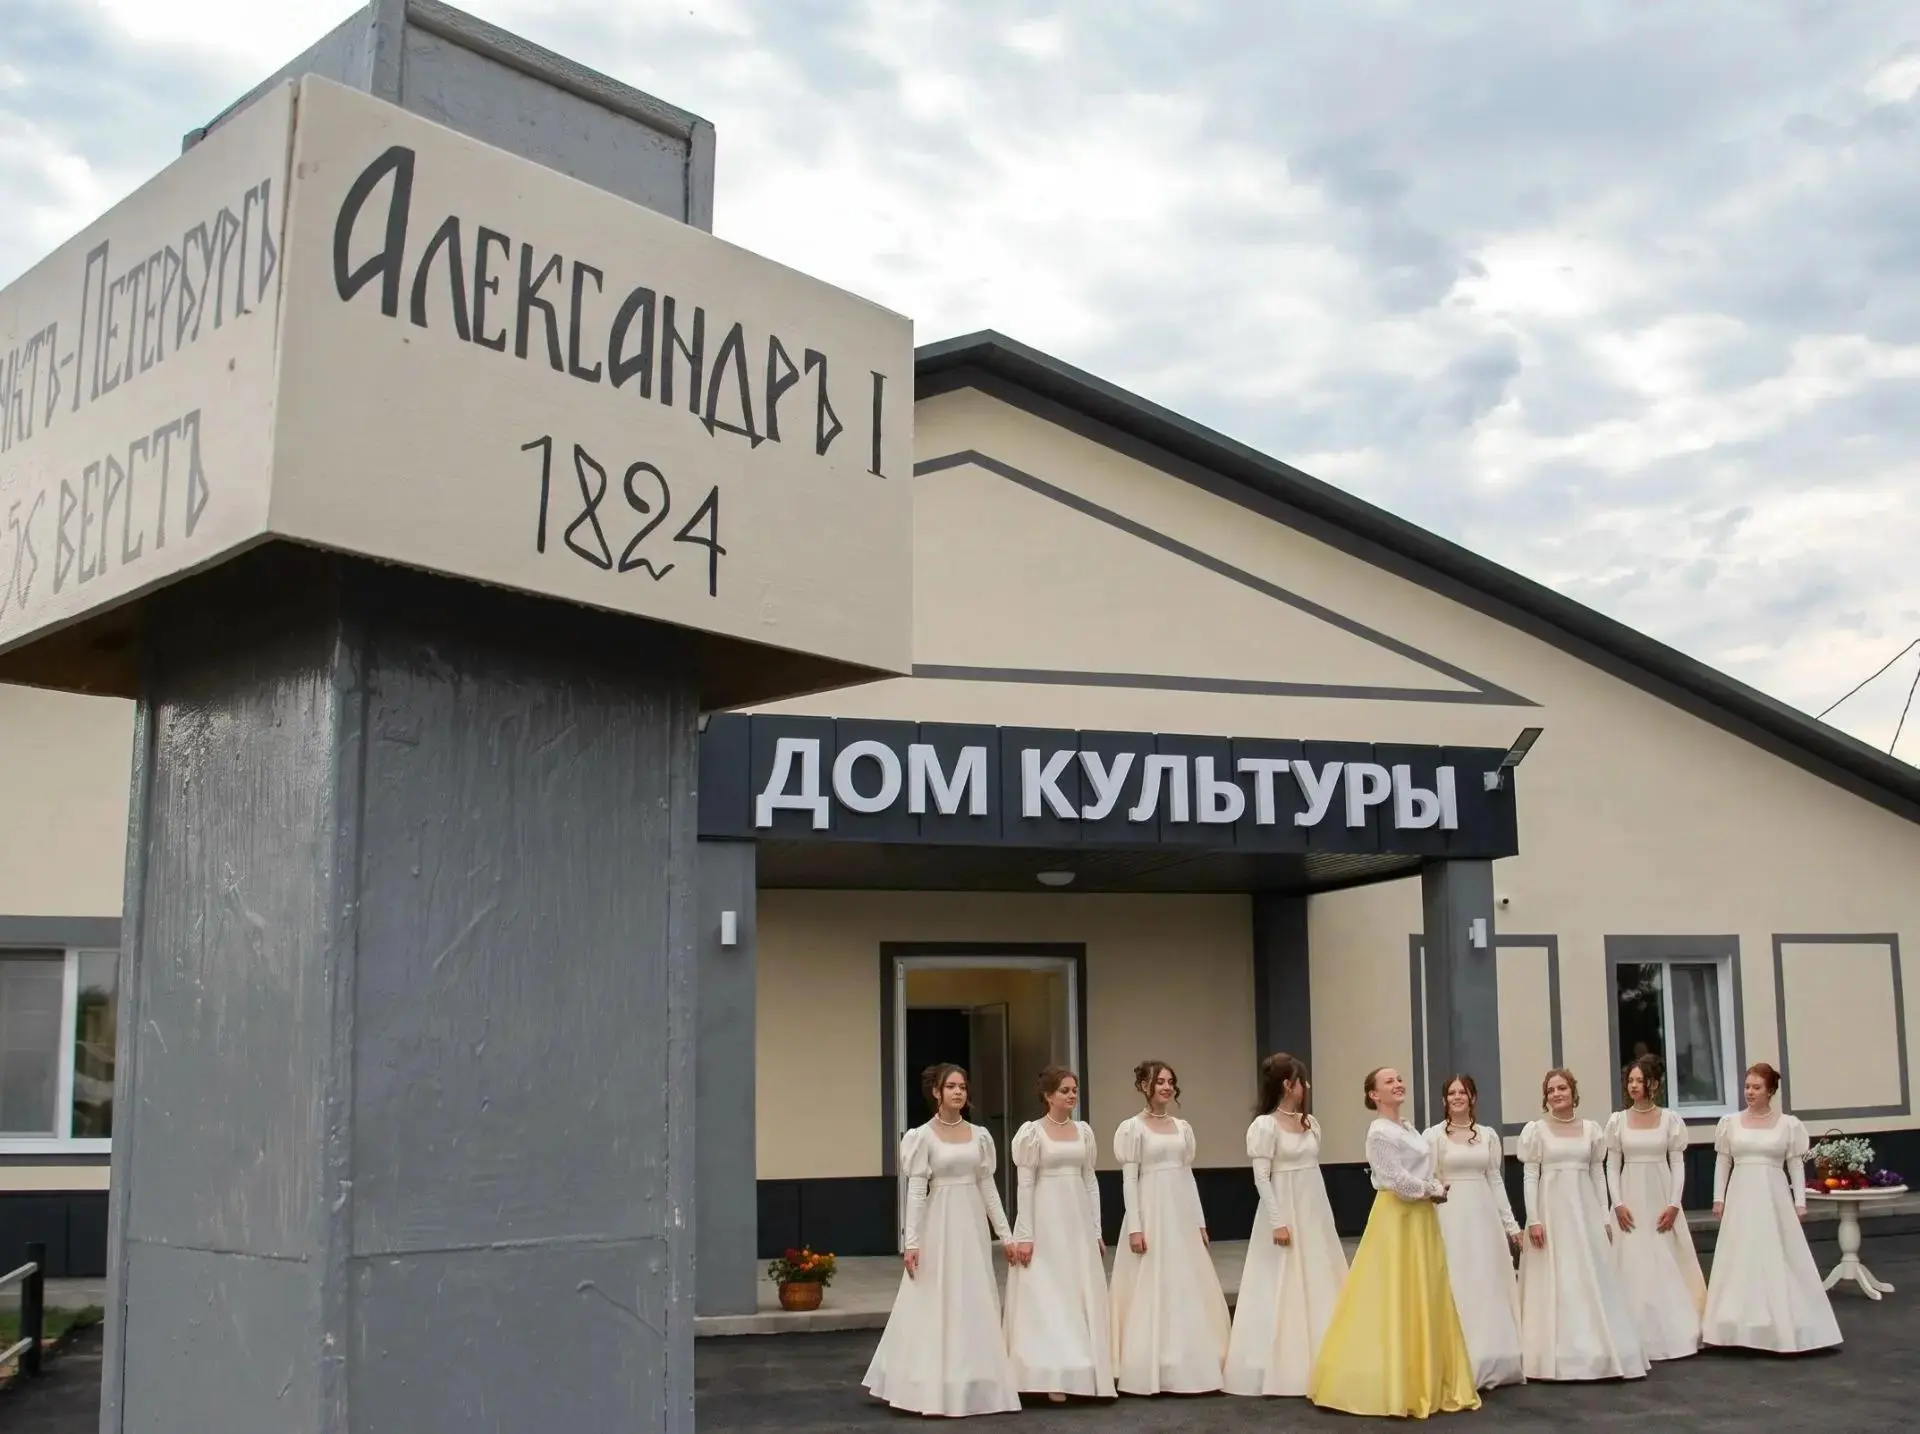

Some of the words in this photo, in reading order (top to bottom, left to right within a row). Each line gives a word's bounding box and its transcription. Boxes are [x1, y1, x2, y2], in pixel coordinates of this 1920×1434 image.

[53, 408, 209, 595] ВЕРСТЪ
[521, 435, 727, 597] 1824
[755, 737, 987, 830] ДОМ
[1022, 748, 1458, 830] КУЛЬТУРЫ
